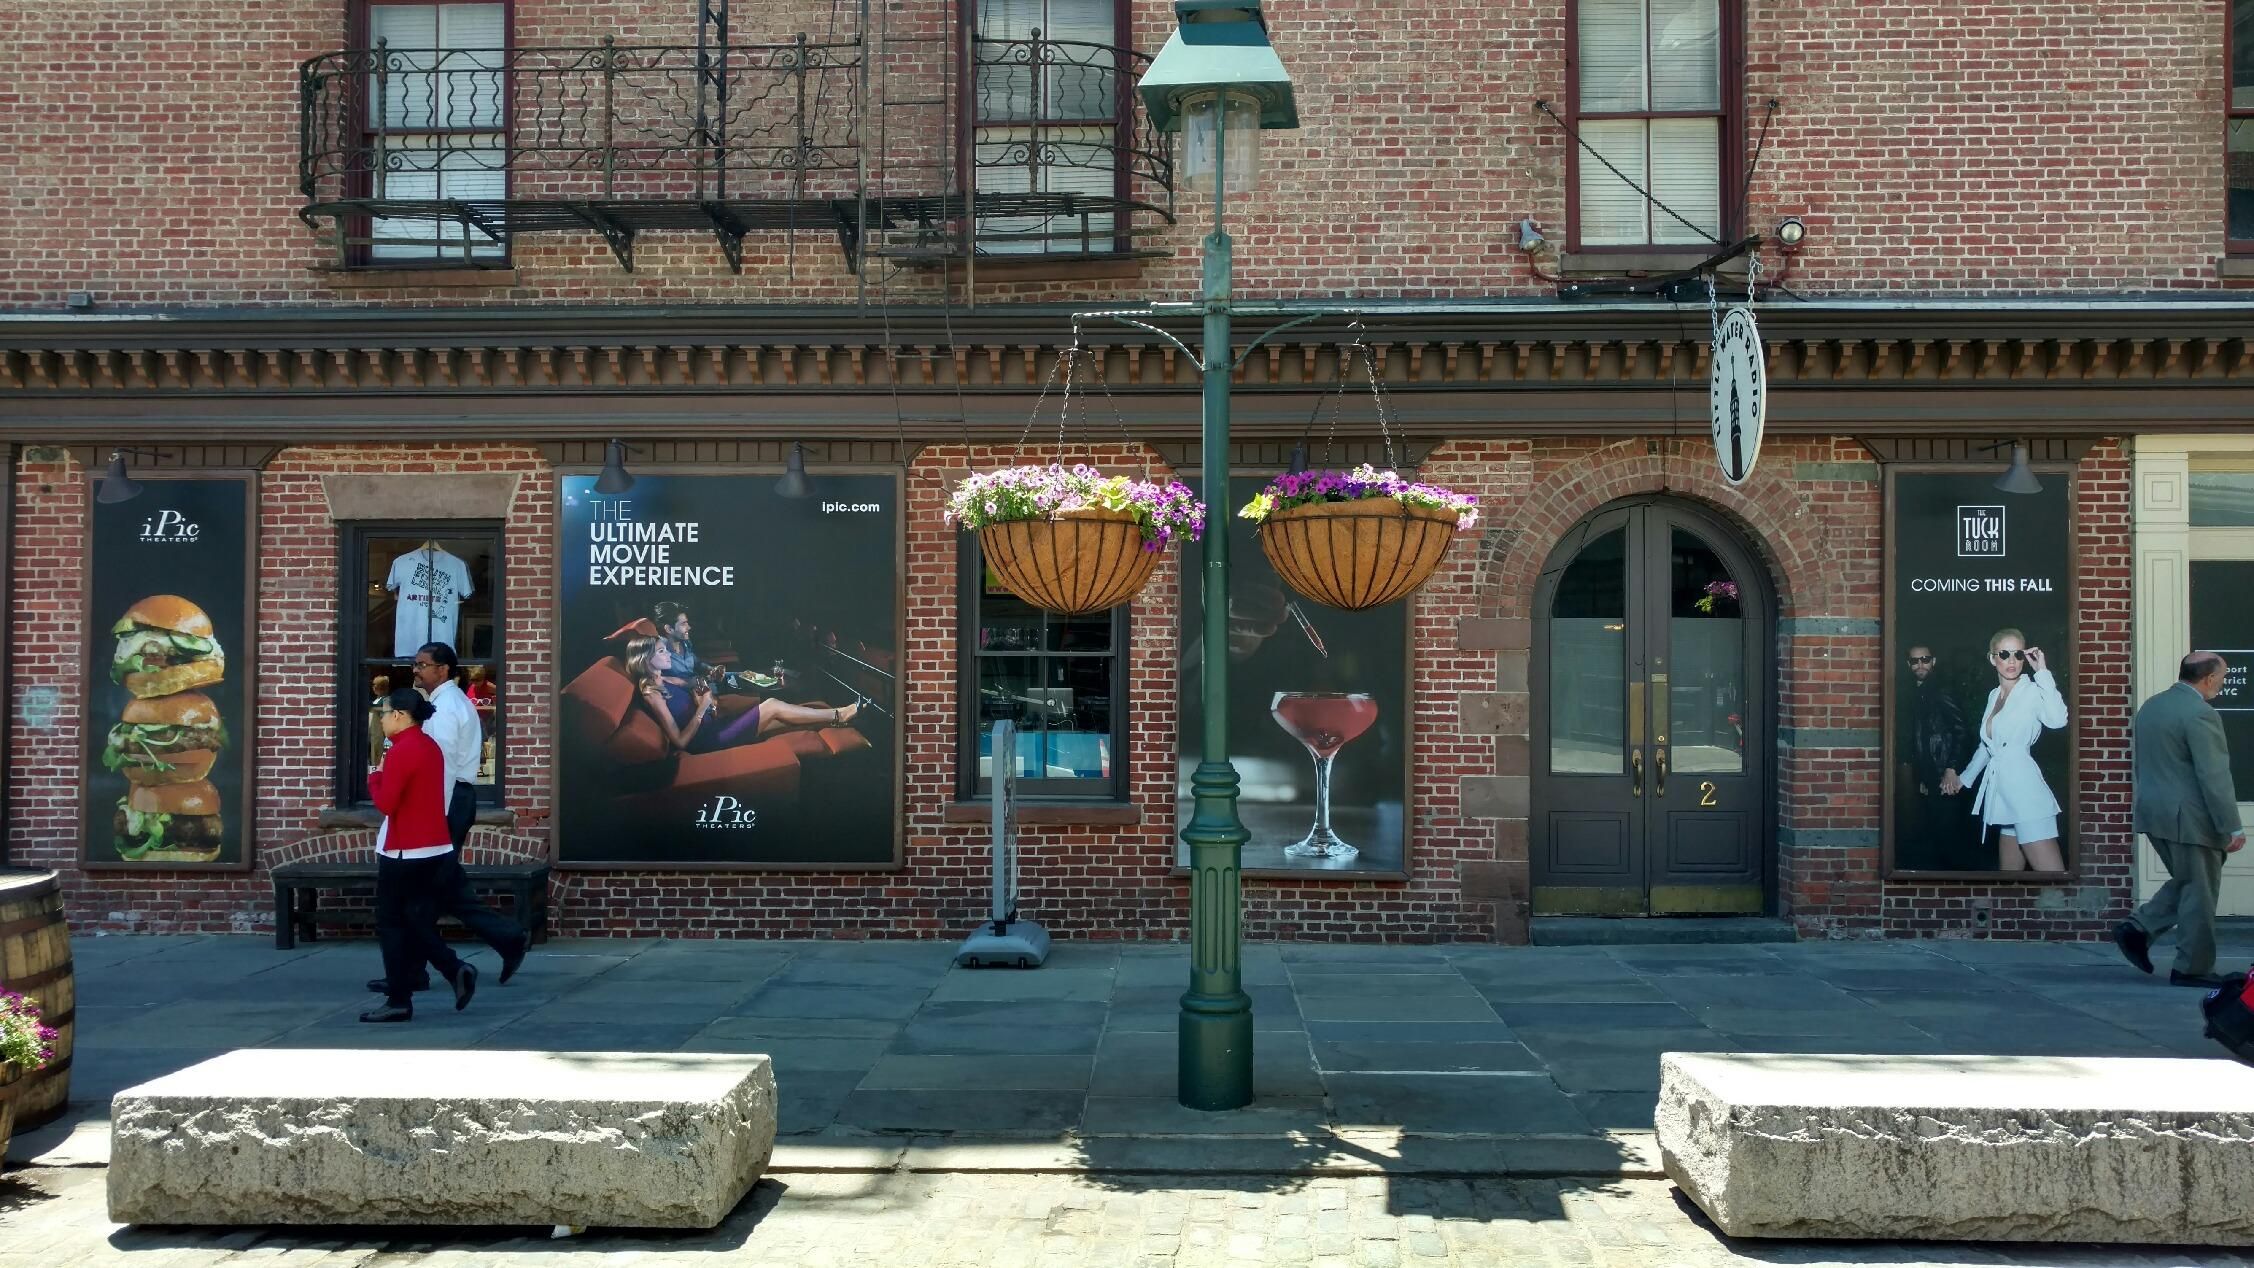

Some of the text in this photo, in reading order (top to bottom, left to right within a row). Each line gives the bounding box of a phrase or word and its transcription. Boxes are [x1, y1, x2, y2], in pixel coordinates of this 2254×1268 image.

[1720, 321, 1743, 352] WATER
[1745, 336, 1758, 418] RADIO
[590, 500, 631, 521] THE
[822, 501, 880, 514] ipic.com
[139, 510, 200, 537] iPic
[590, 523, 699, 542] ULTIMATE
[1963, 517, 1999, 539] TUCK
[590, 544, 670, 564] MOVIE
[1965, 540, 1998, 551] ROOM
[589, 566, 734, 586] EXPERIENCE
[1911, 578, 2053, 592] COMING THIS FALL
[2224, 676, 2247, 684] trict
[1700, 781, 1717, 805] 2
[696, 796, 756, 822] iPic
